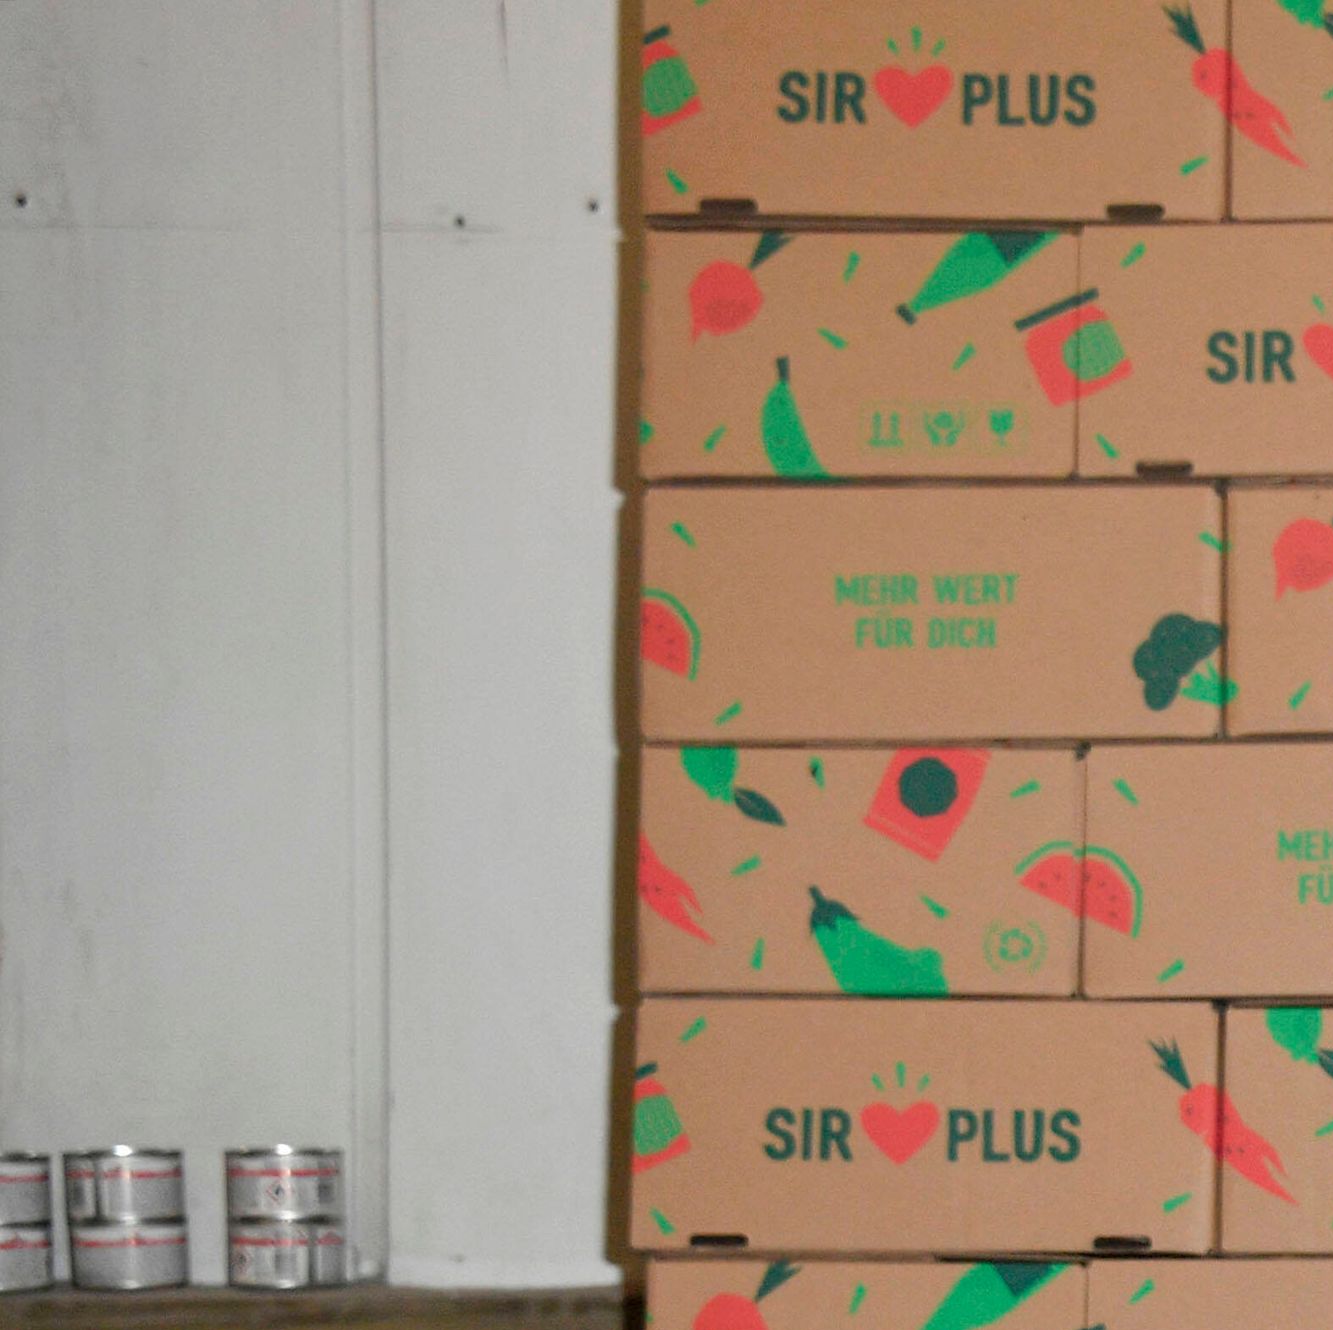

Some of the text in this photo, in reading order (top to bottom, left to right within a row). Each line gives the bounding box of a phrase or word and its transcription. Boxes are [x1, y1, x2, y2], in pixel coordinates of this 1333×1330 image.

[776, 68, 1097, 128] SIR PLUS
[1205, 328, 1296, 386] SIR
[834, 573, 1019, 606] MEHR WERT
[854, 610, 997, 649] FÜR DICH
[763, 1106, 1081, 1164] SIR PLUS
